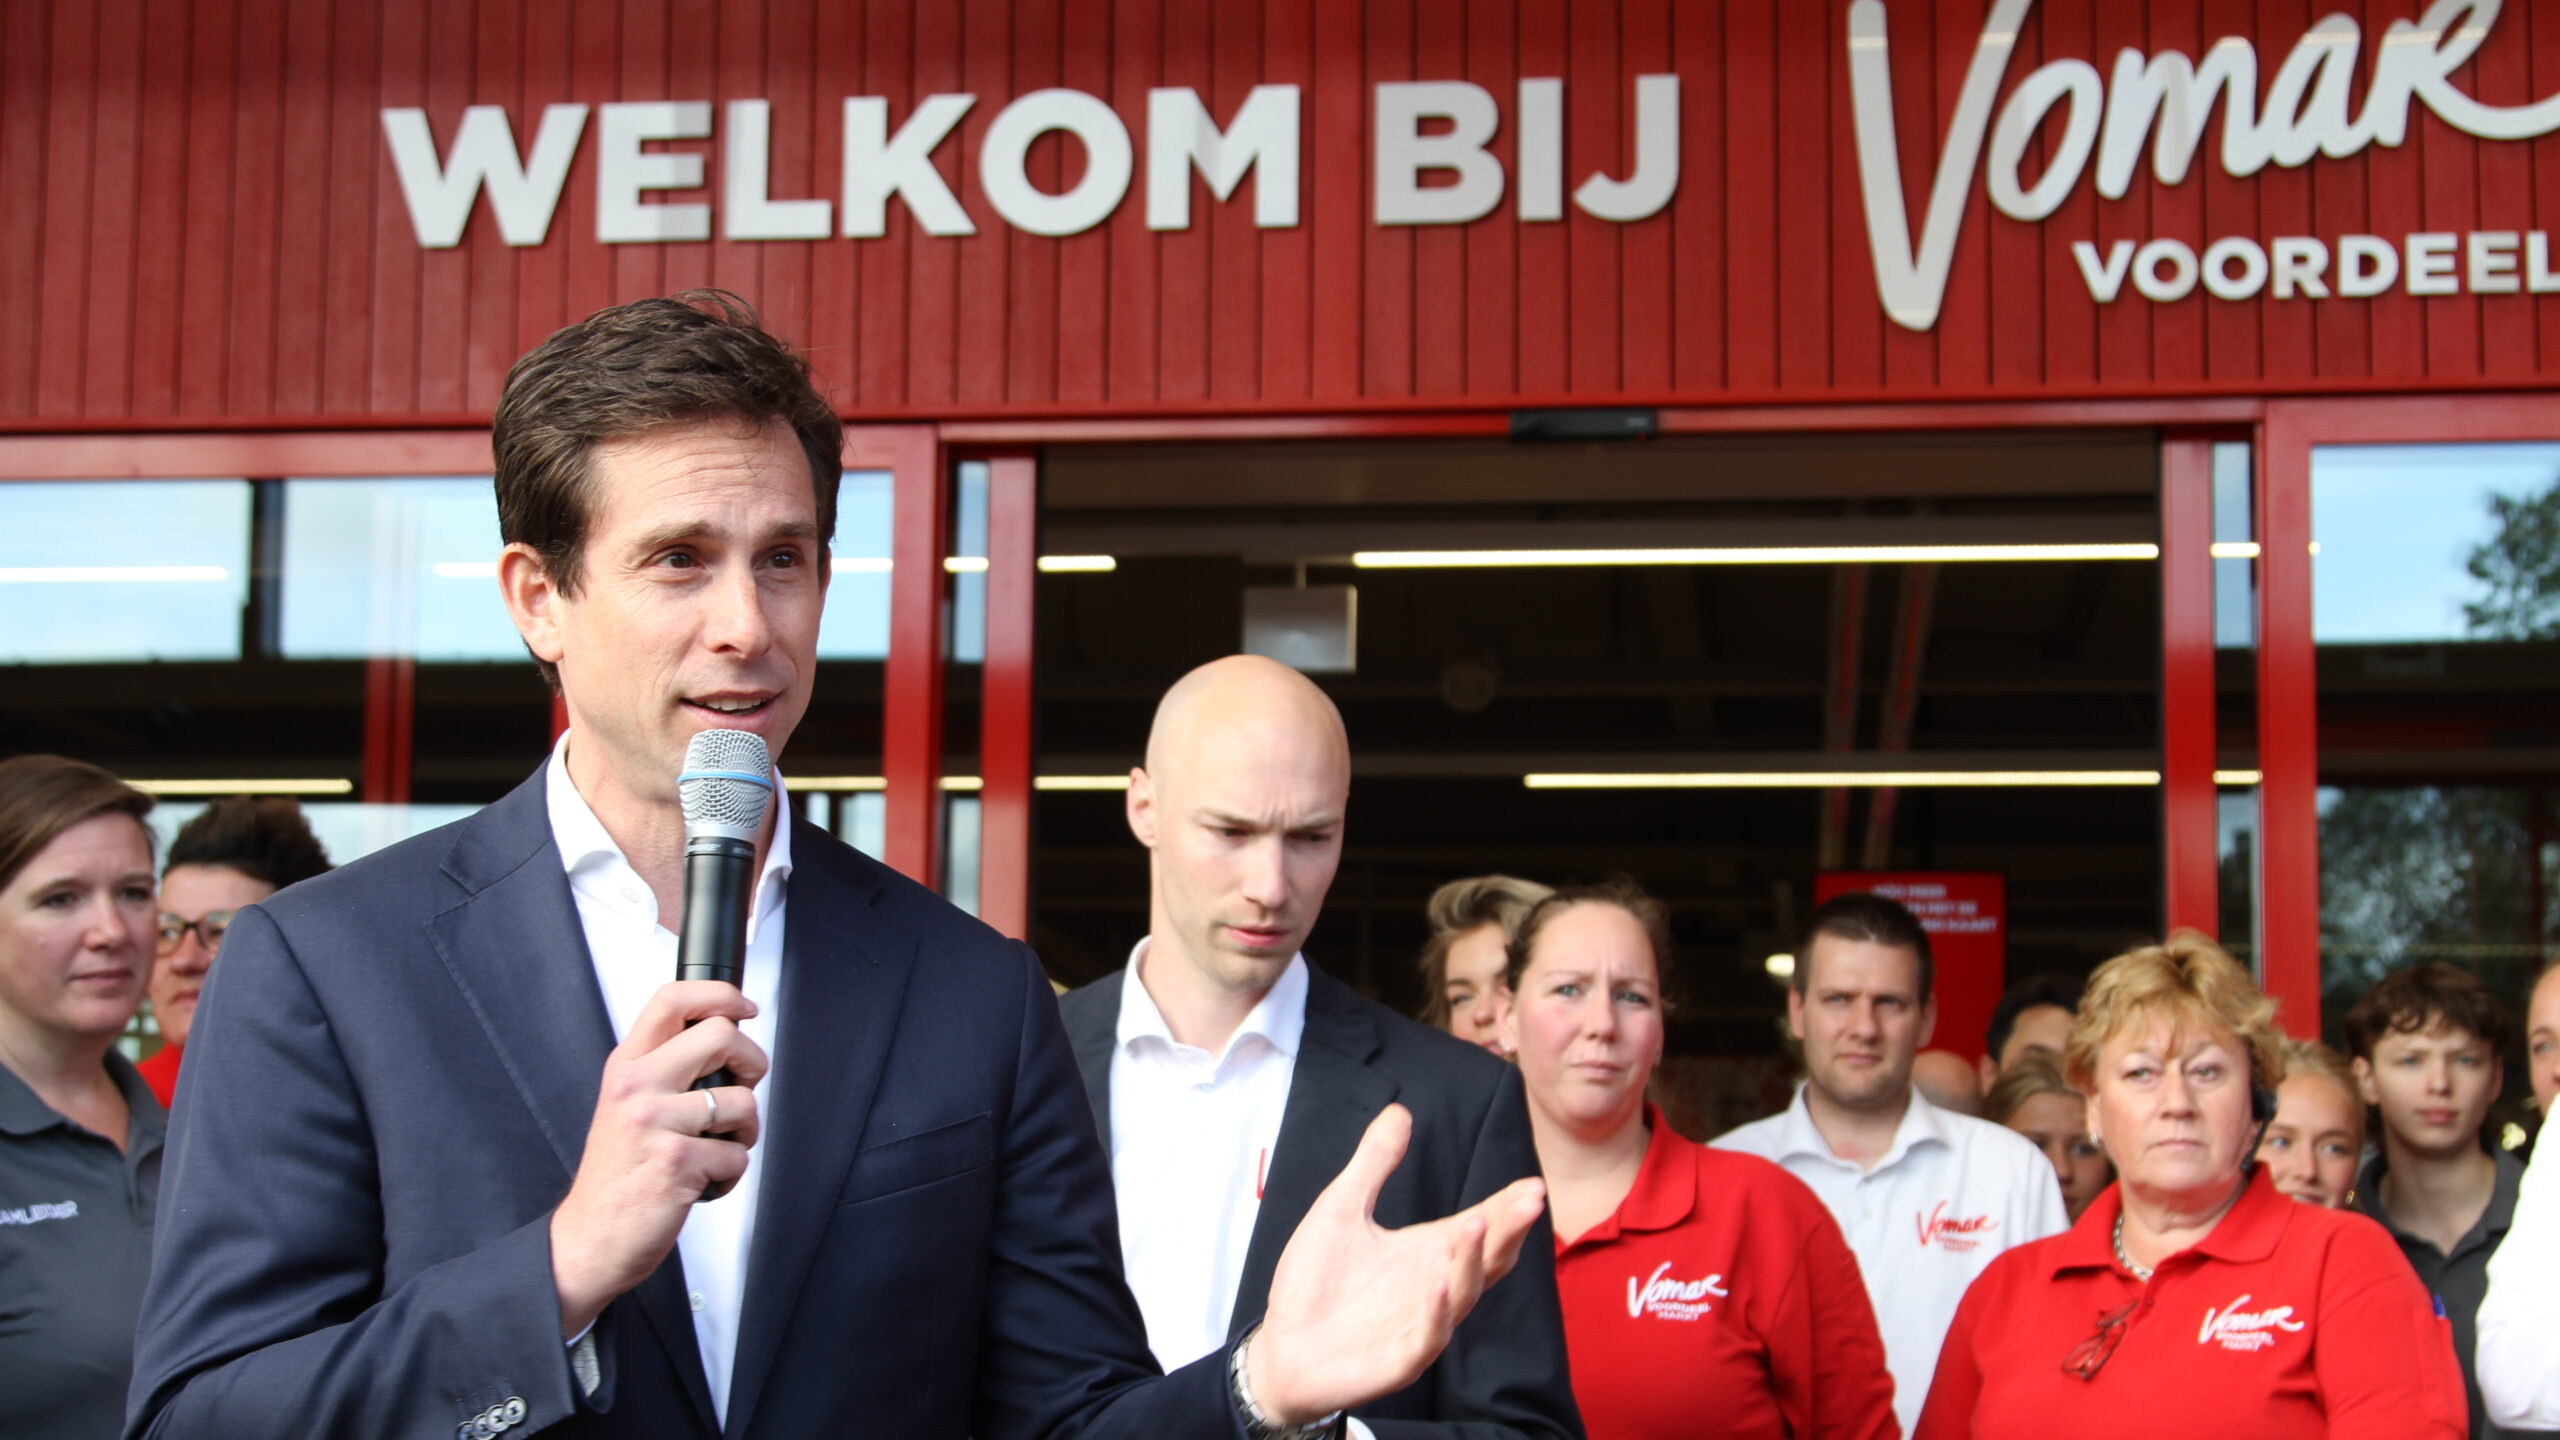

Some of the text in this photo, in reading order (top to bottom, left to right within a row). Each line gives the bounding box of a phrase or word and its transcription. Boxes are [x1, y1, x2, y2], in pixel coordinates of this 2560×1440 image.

[380, 73, 1681, 249] WELKOM BIJ
[1847, 0, 2560, 333] Vomar
[2071, 230, 2560, 303] VOORDEEL
[1627, 1260, 1729, 1319] Vomar
[1646, 1301, 1711, 1314] VOORDEEL
